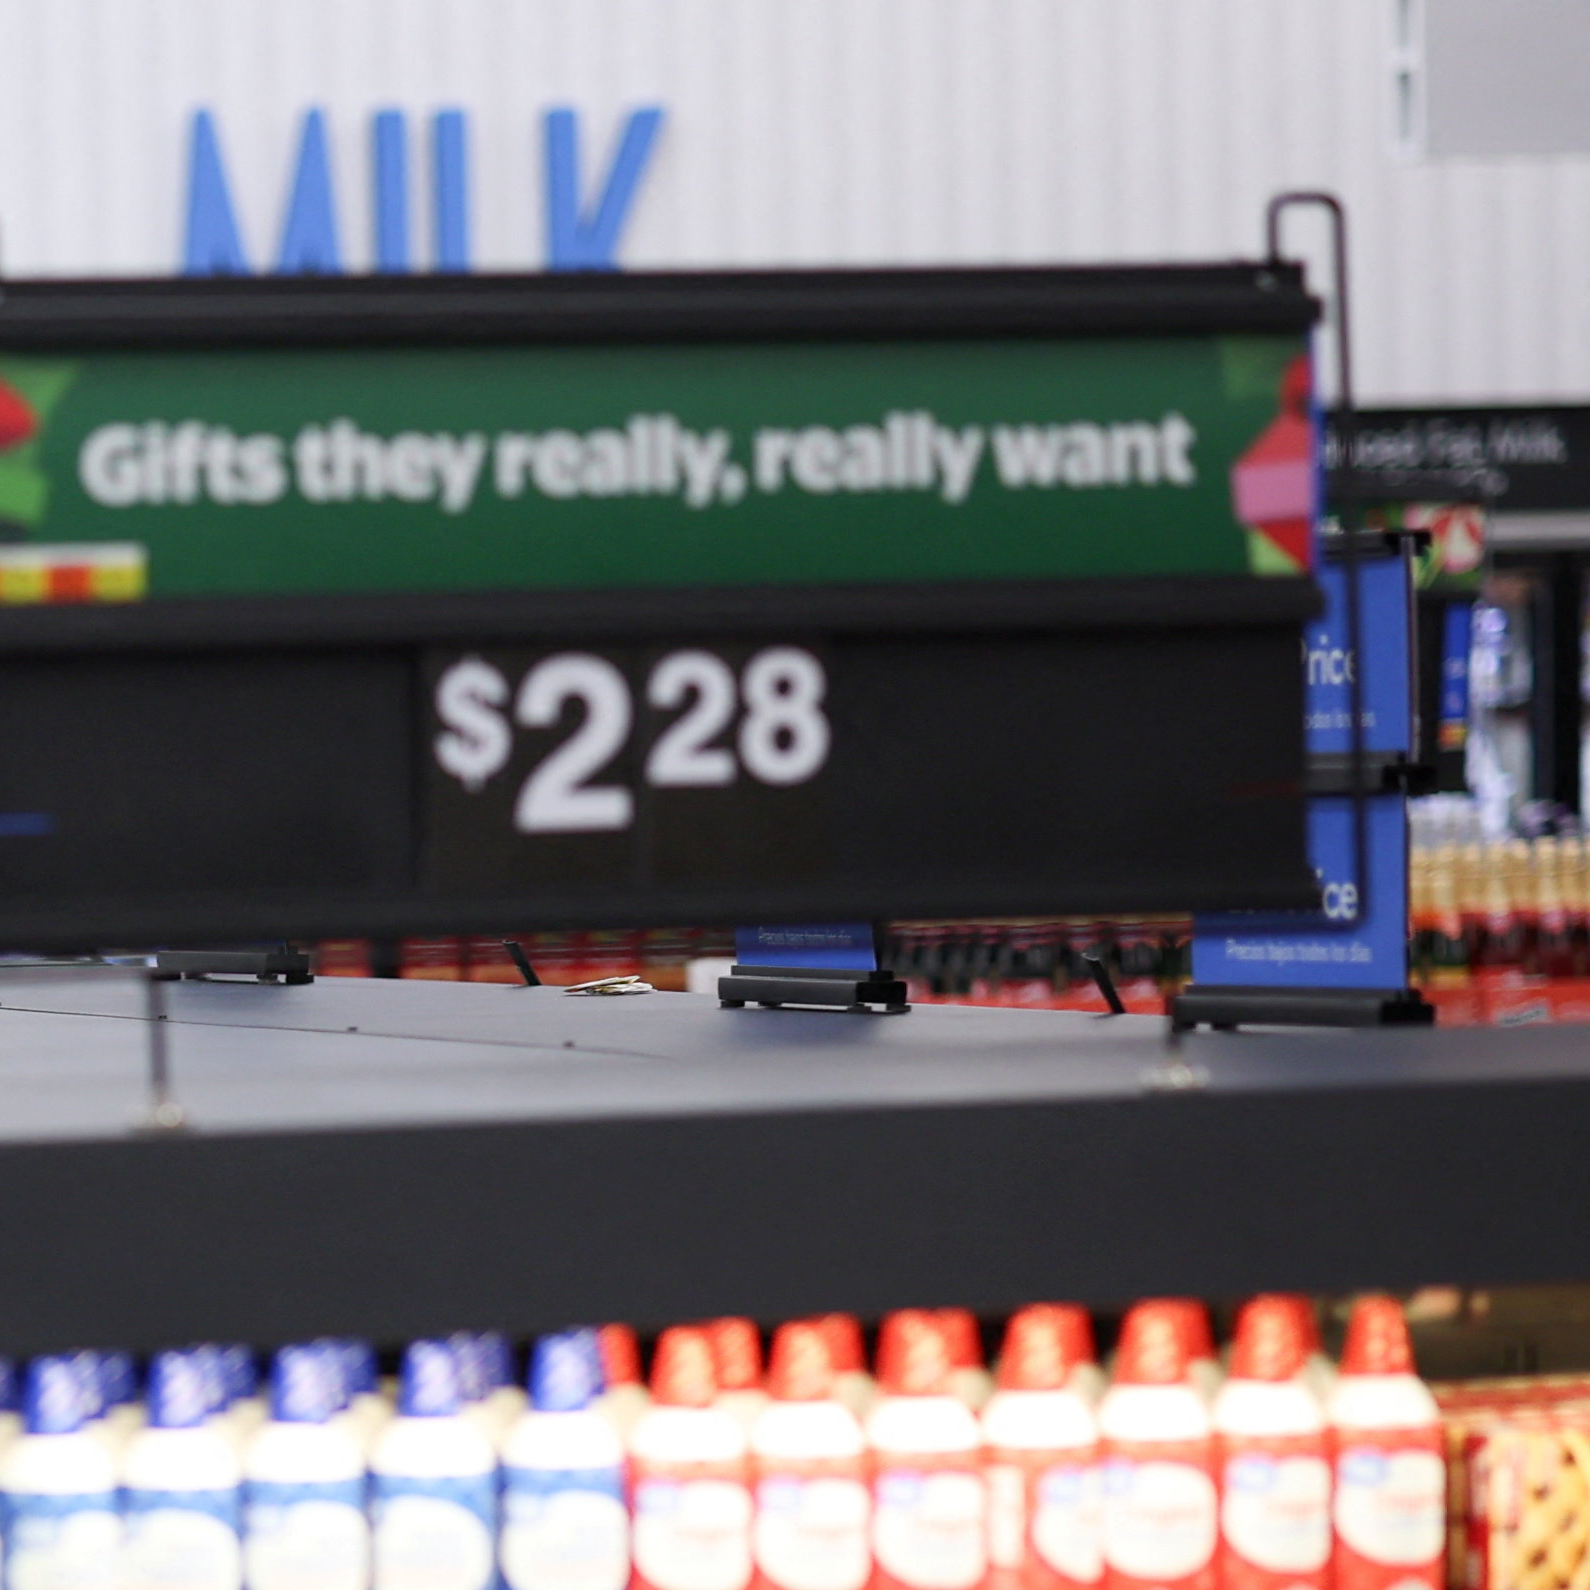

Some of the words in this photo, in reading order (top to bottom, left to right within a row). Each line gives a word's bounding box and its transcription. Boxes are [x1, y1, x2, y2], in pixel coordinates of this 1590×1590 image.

[78, 418, 288, 508] Gifts
[295, 416, 486, 515] they
[495, 411, 747, 509] really,
[754, 409, 985, 504] really
[992, 410, 1196, 489] want
[1300, 633, 1356, 686] ric
